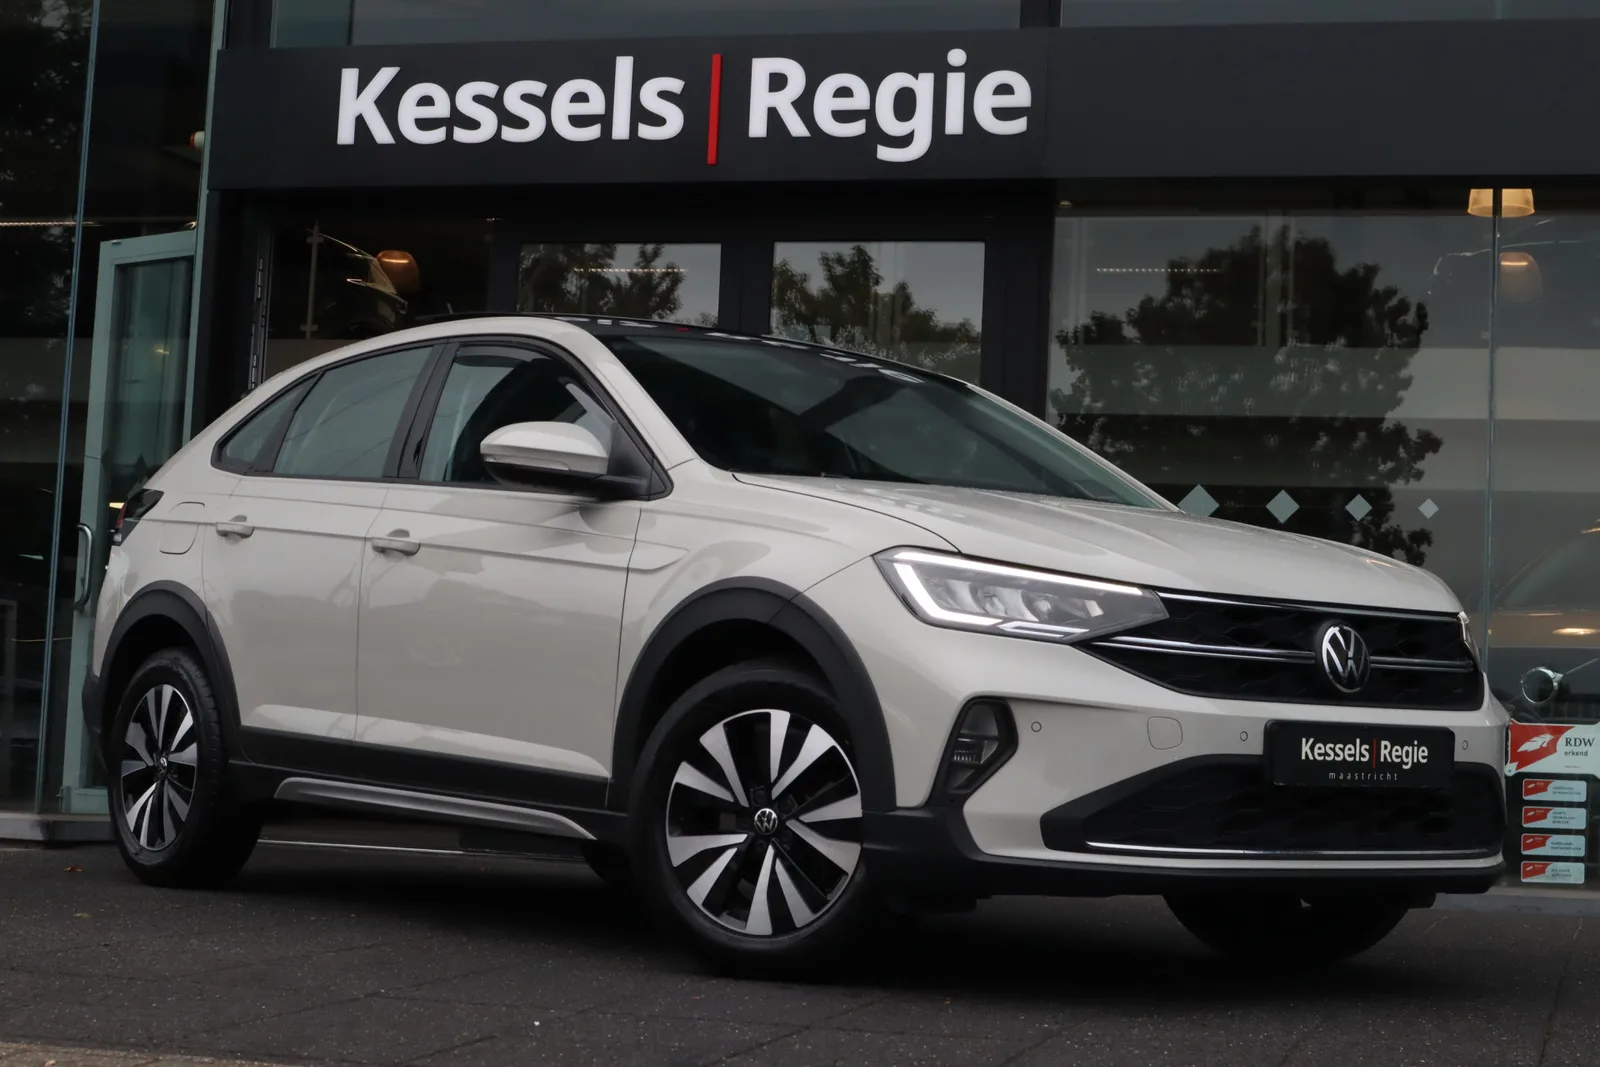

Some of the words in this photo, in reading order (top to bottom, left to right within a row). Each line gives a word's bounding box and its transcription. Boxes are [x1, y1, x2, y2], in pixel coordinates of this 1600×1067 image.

[336, 55, 686, 145] Kessels
[747, 48, 1033, 163] Regie
[1564, 737, 1596, 747] RDW
[1301, 737, 1370, 762] Kessels
[1380, 740, 1429, 770] Regie
[1564, 749, 1589, 757] erkend
[1328, 772, 1399, 781] maastricht
